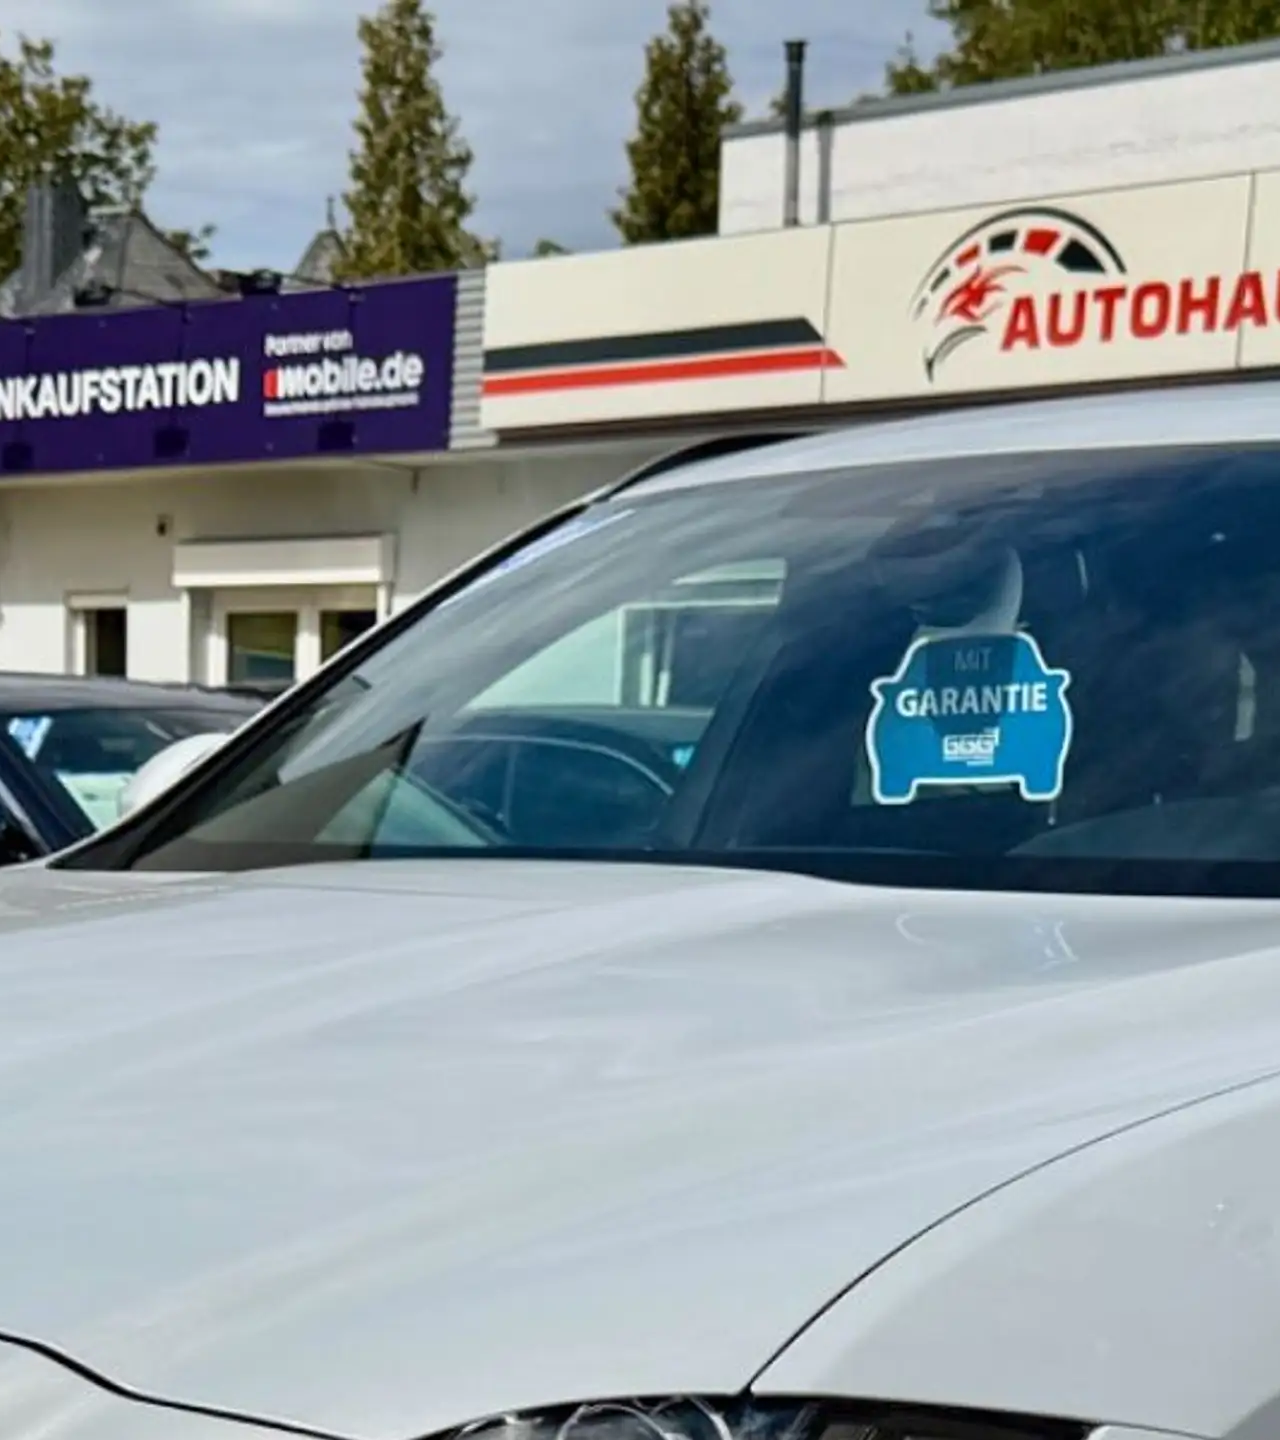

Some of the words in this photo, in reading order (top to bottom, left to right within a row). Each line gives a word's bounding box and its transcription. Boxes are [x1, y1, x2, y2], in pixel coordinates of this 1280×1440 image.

[277, 351, 424, 398] mobile.de
[954, 650, 992, 672] MIT
[895, 682, 1048, 718] GARANTIE
